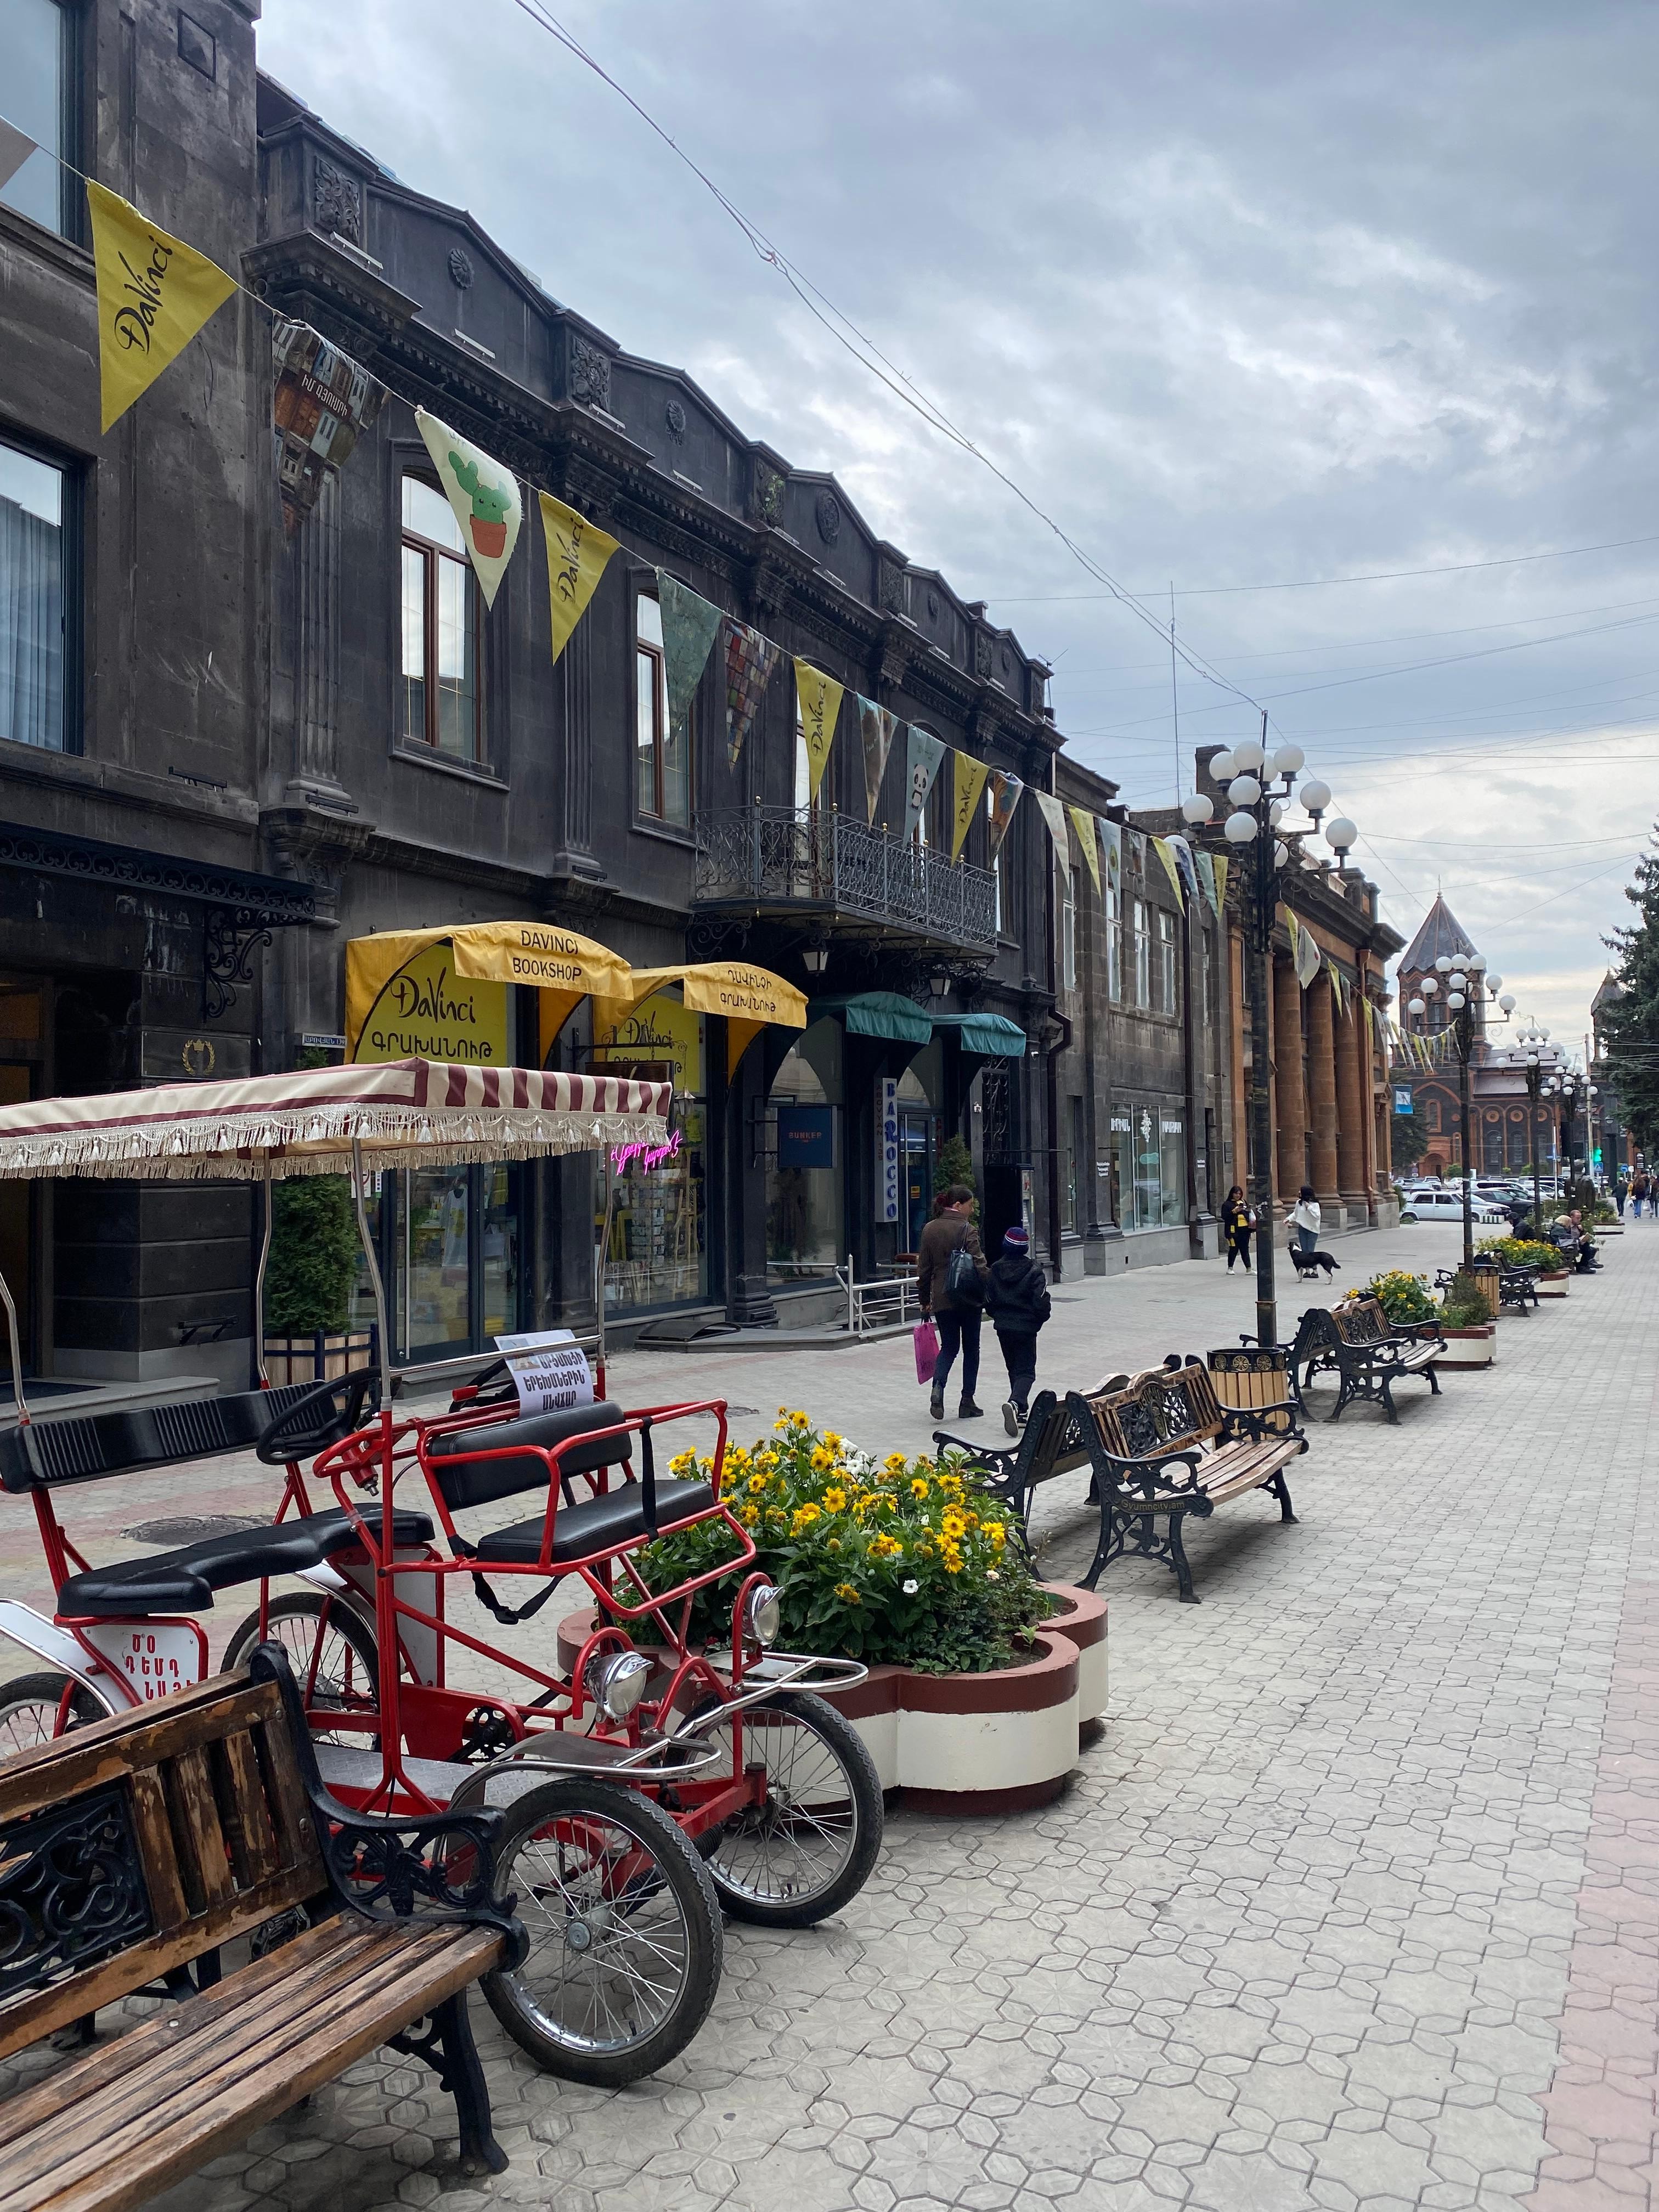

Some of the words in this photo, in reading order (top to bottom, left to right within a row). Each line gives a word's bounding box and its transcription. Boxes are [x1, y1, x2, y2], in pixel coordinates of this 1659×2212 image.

[114, 234, 173, 356] DaVinci
[301, 374, 317, 392] ԻՄ
[316, 384, 348, 416] ԳՅՈՒՄՐԻ
[556, 517, 584, 604] DaVinci
[808, 682, 826, 757] DaVinci
[521, 930, 579, 955] DAVINCI
[512, 957, 582, 981] BOOKSHOP
[727, 970, 772, 990] ԴԱՎԻՆՉԻ
[390, 967, 476, 1023] DaVinci
[720, 992, 776, 1012] ԳՐԱԽԱՆՈՒԹ
[305, 1036, 335, 1045] ԱԲՈՎՅԱՆ
[371, 1031, 493, 1059] ԳՐԱԽԱՆՈՒԹ
[884, 1082, 900, 1218] BAROCCO
[542, 1390, 577, 1411] ԱՆՎՃԱՐ
[125, 1655, 179, 1678] ԴԵՄԴ
